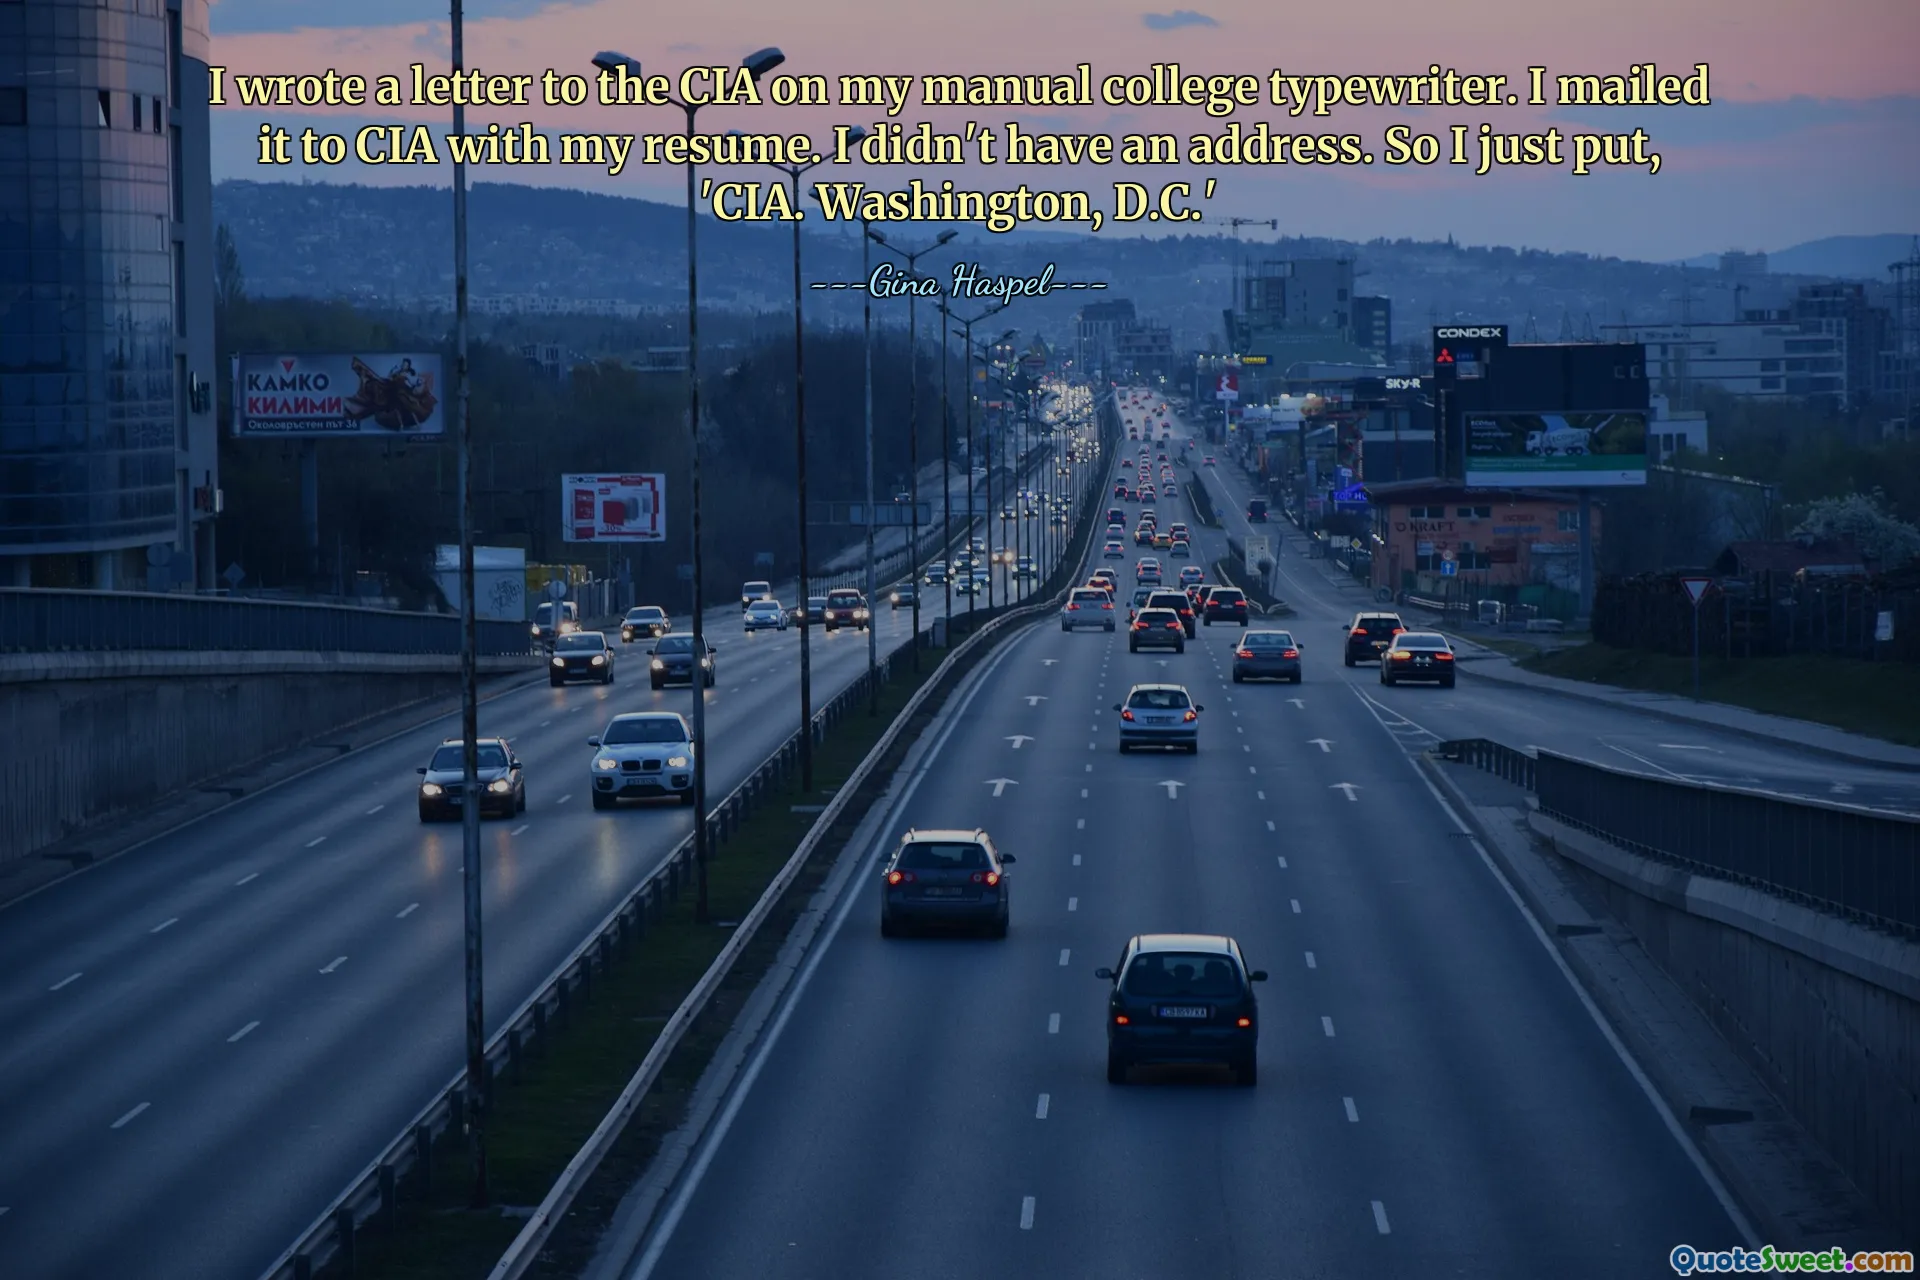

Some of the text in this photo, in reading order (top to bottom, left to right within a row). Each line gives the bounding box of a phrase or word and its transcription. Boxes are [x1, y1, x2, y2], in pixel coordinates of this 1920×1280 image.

[1436, 327, 1502, 339] CONDEX
[247, 373, 330, 392] КАМКО
[247, 396, 342, 414] КИЛИМИ
[1409, 520, 1456, 533] KRAFT
